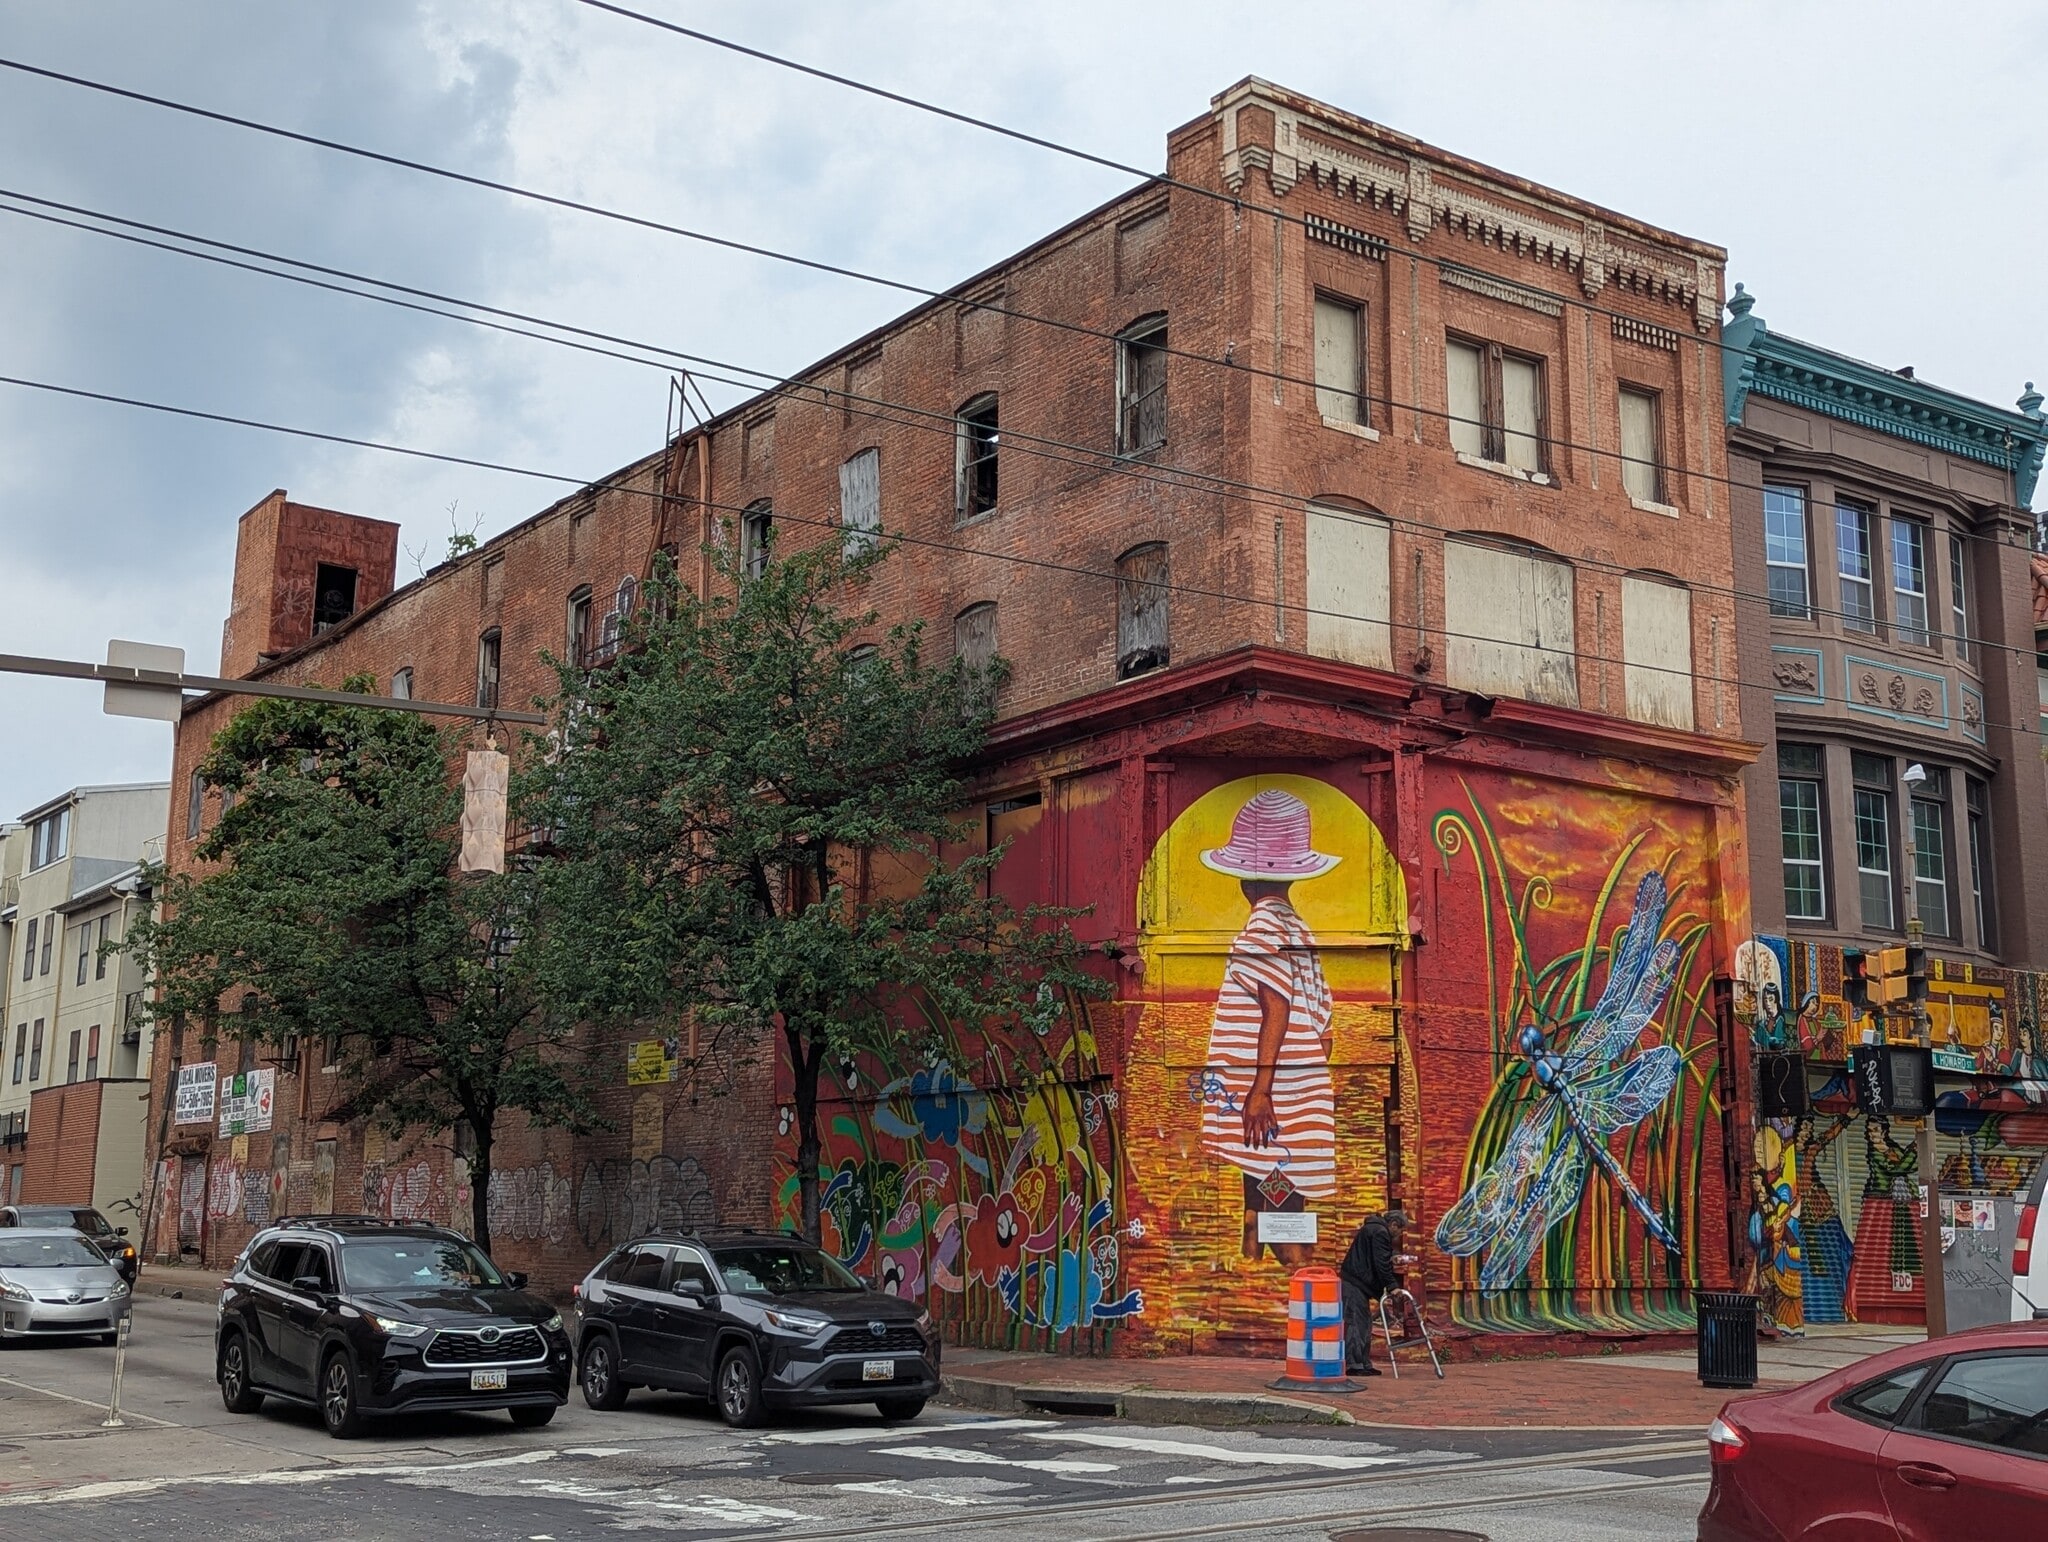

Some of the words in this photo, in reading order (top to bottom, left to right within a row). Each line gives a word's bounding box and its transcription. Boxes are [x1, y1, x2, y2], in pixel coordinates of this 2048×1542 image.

[1940, 1054, 1966, 1069] HOWARD
[179, 1068, 194, 1086] LOCAL
[195, 1065, 215, 1084] MOVERS
[1893, 1274, 1911, 1288] FDC
